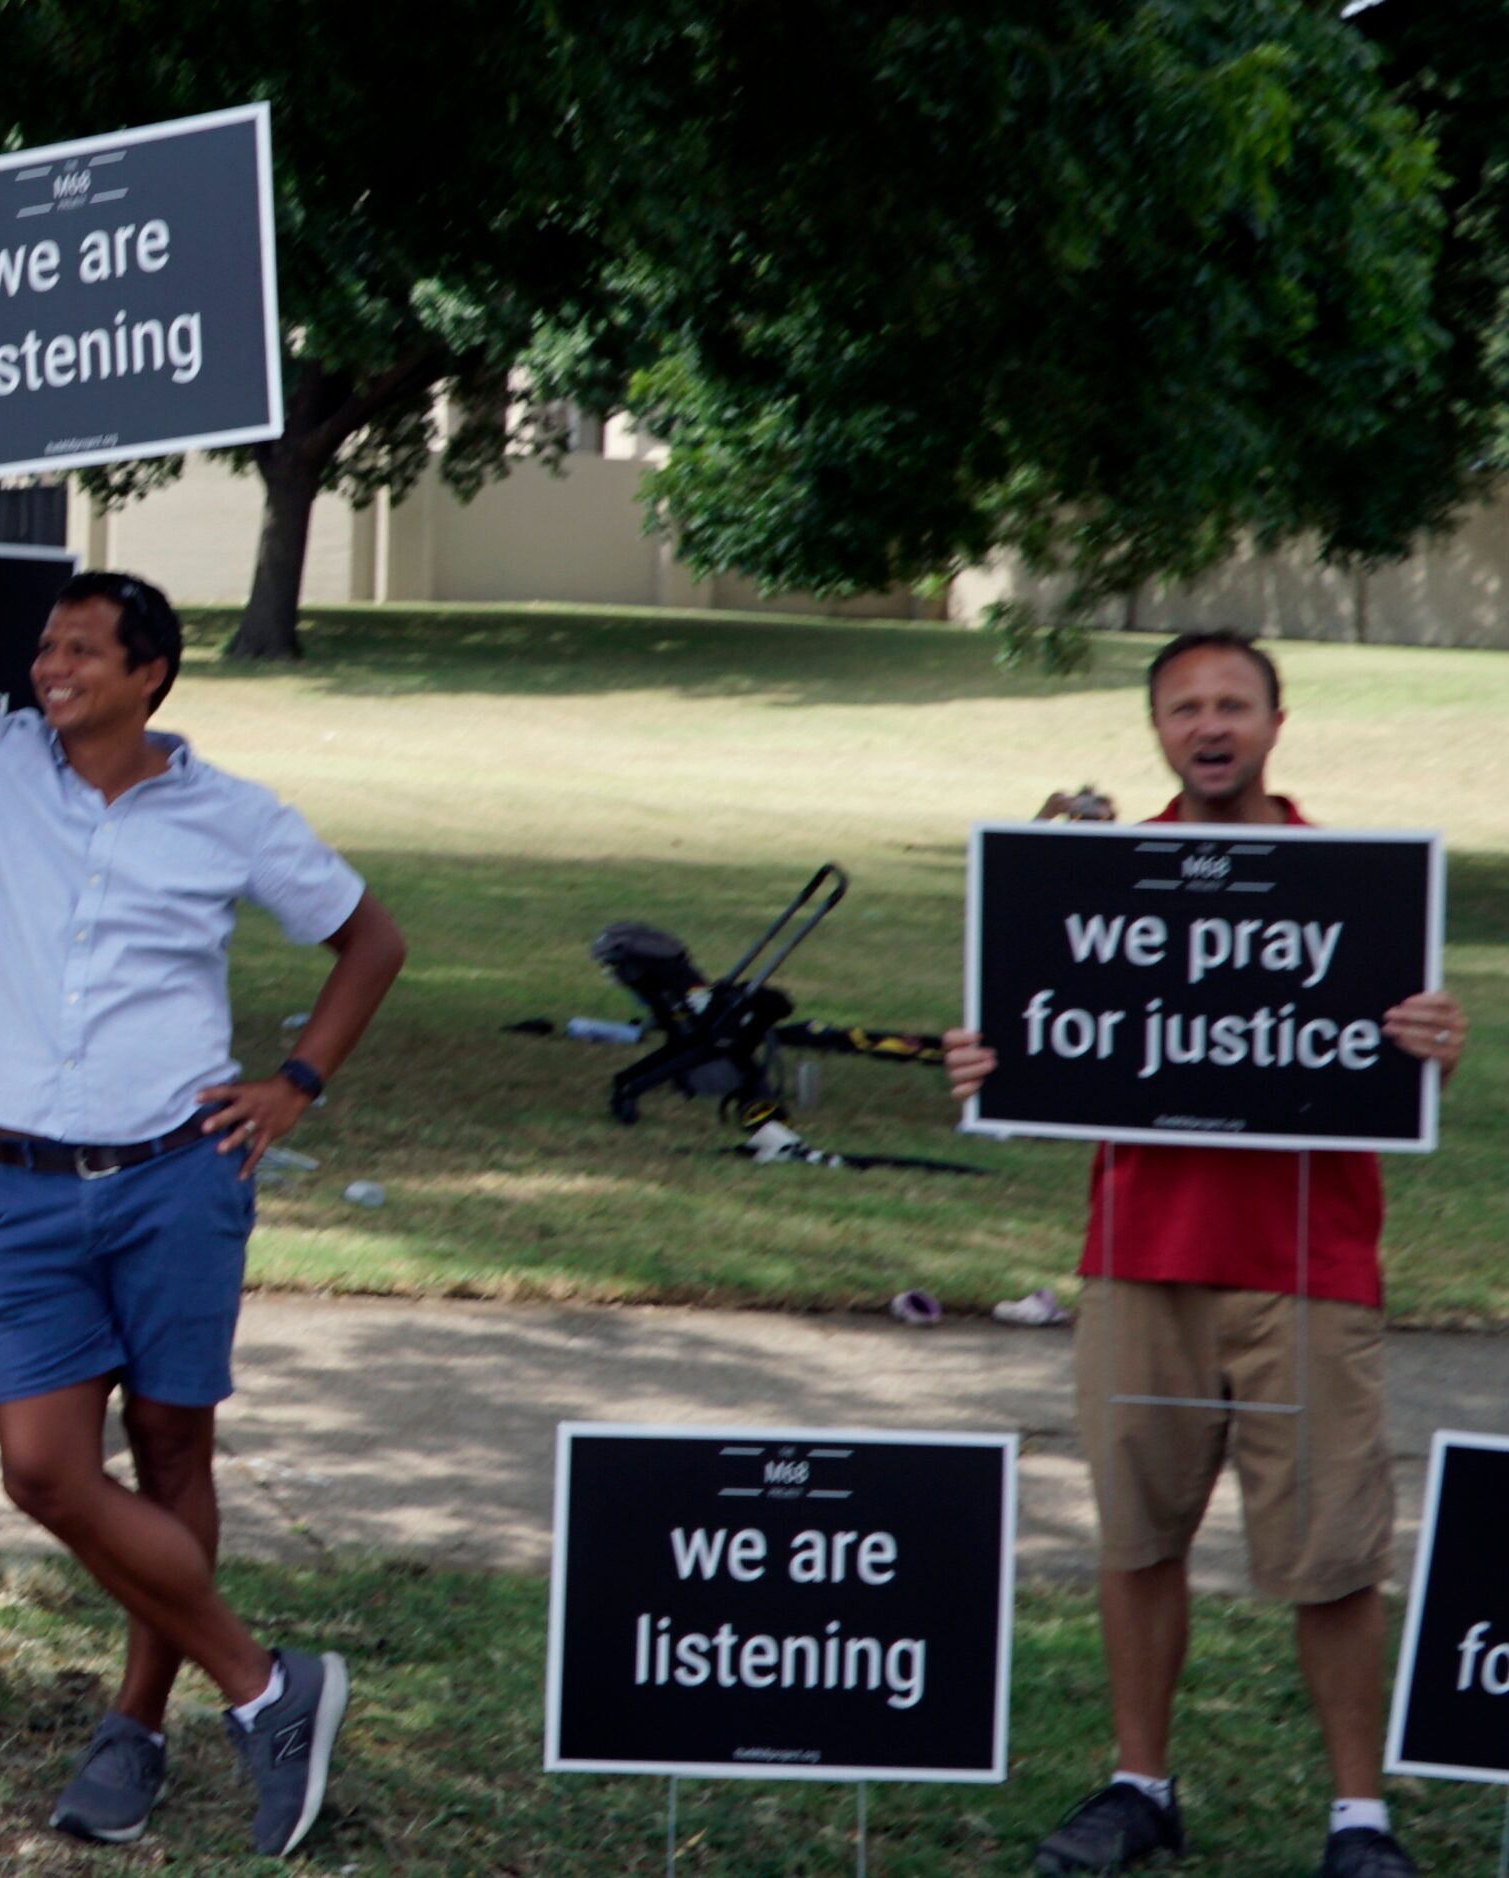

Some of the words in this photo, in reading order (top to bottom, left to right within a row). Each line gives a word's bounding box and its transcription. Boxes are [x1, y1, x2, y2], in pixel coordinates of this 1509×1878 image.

[79, 218, 170, 284] are
[1065, 913, 1169, 966] we
[1187, 917, 1344, 988] pray
[1022, 989, 1126, 1060] for
[1137, 997, 1381, 1079] justice
[763, 1461, 810, 1484] M68
[670, 1527, 768, 1582] we
[788, 1530, 898, 1585] are
[634, 1613, 927, 1709] listening
